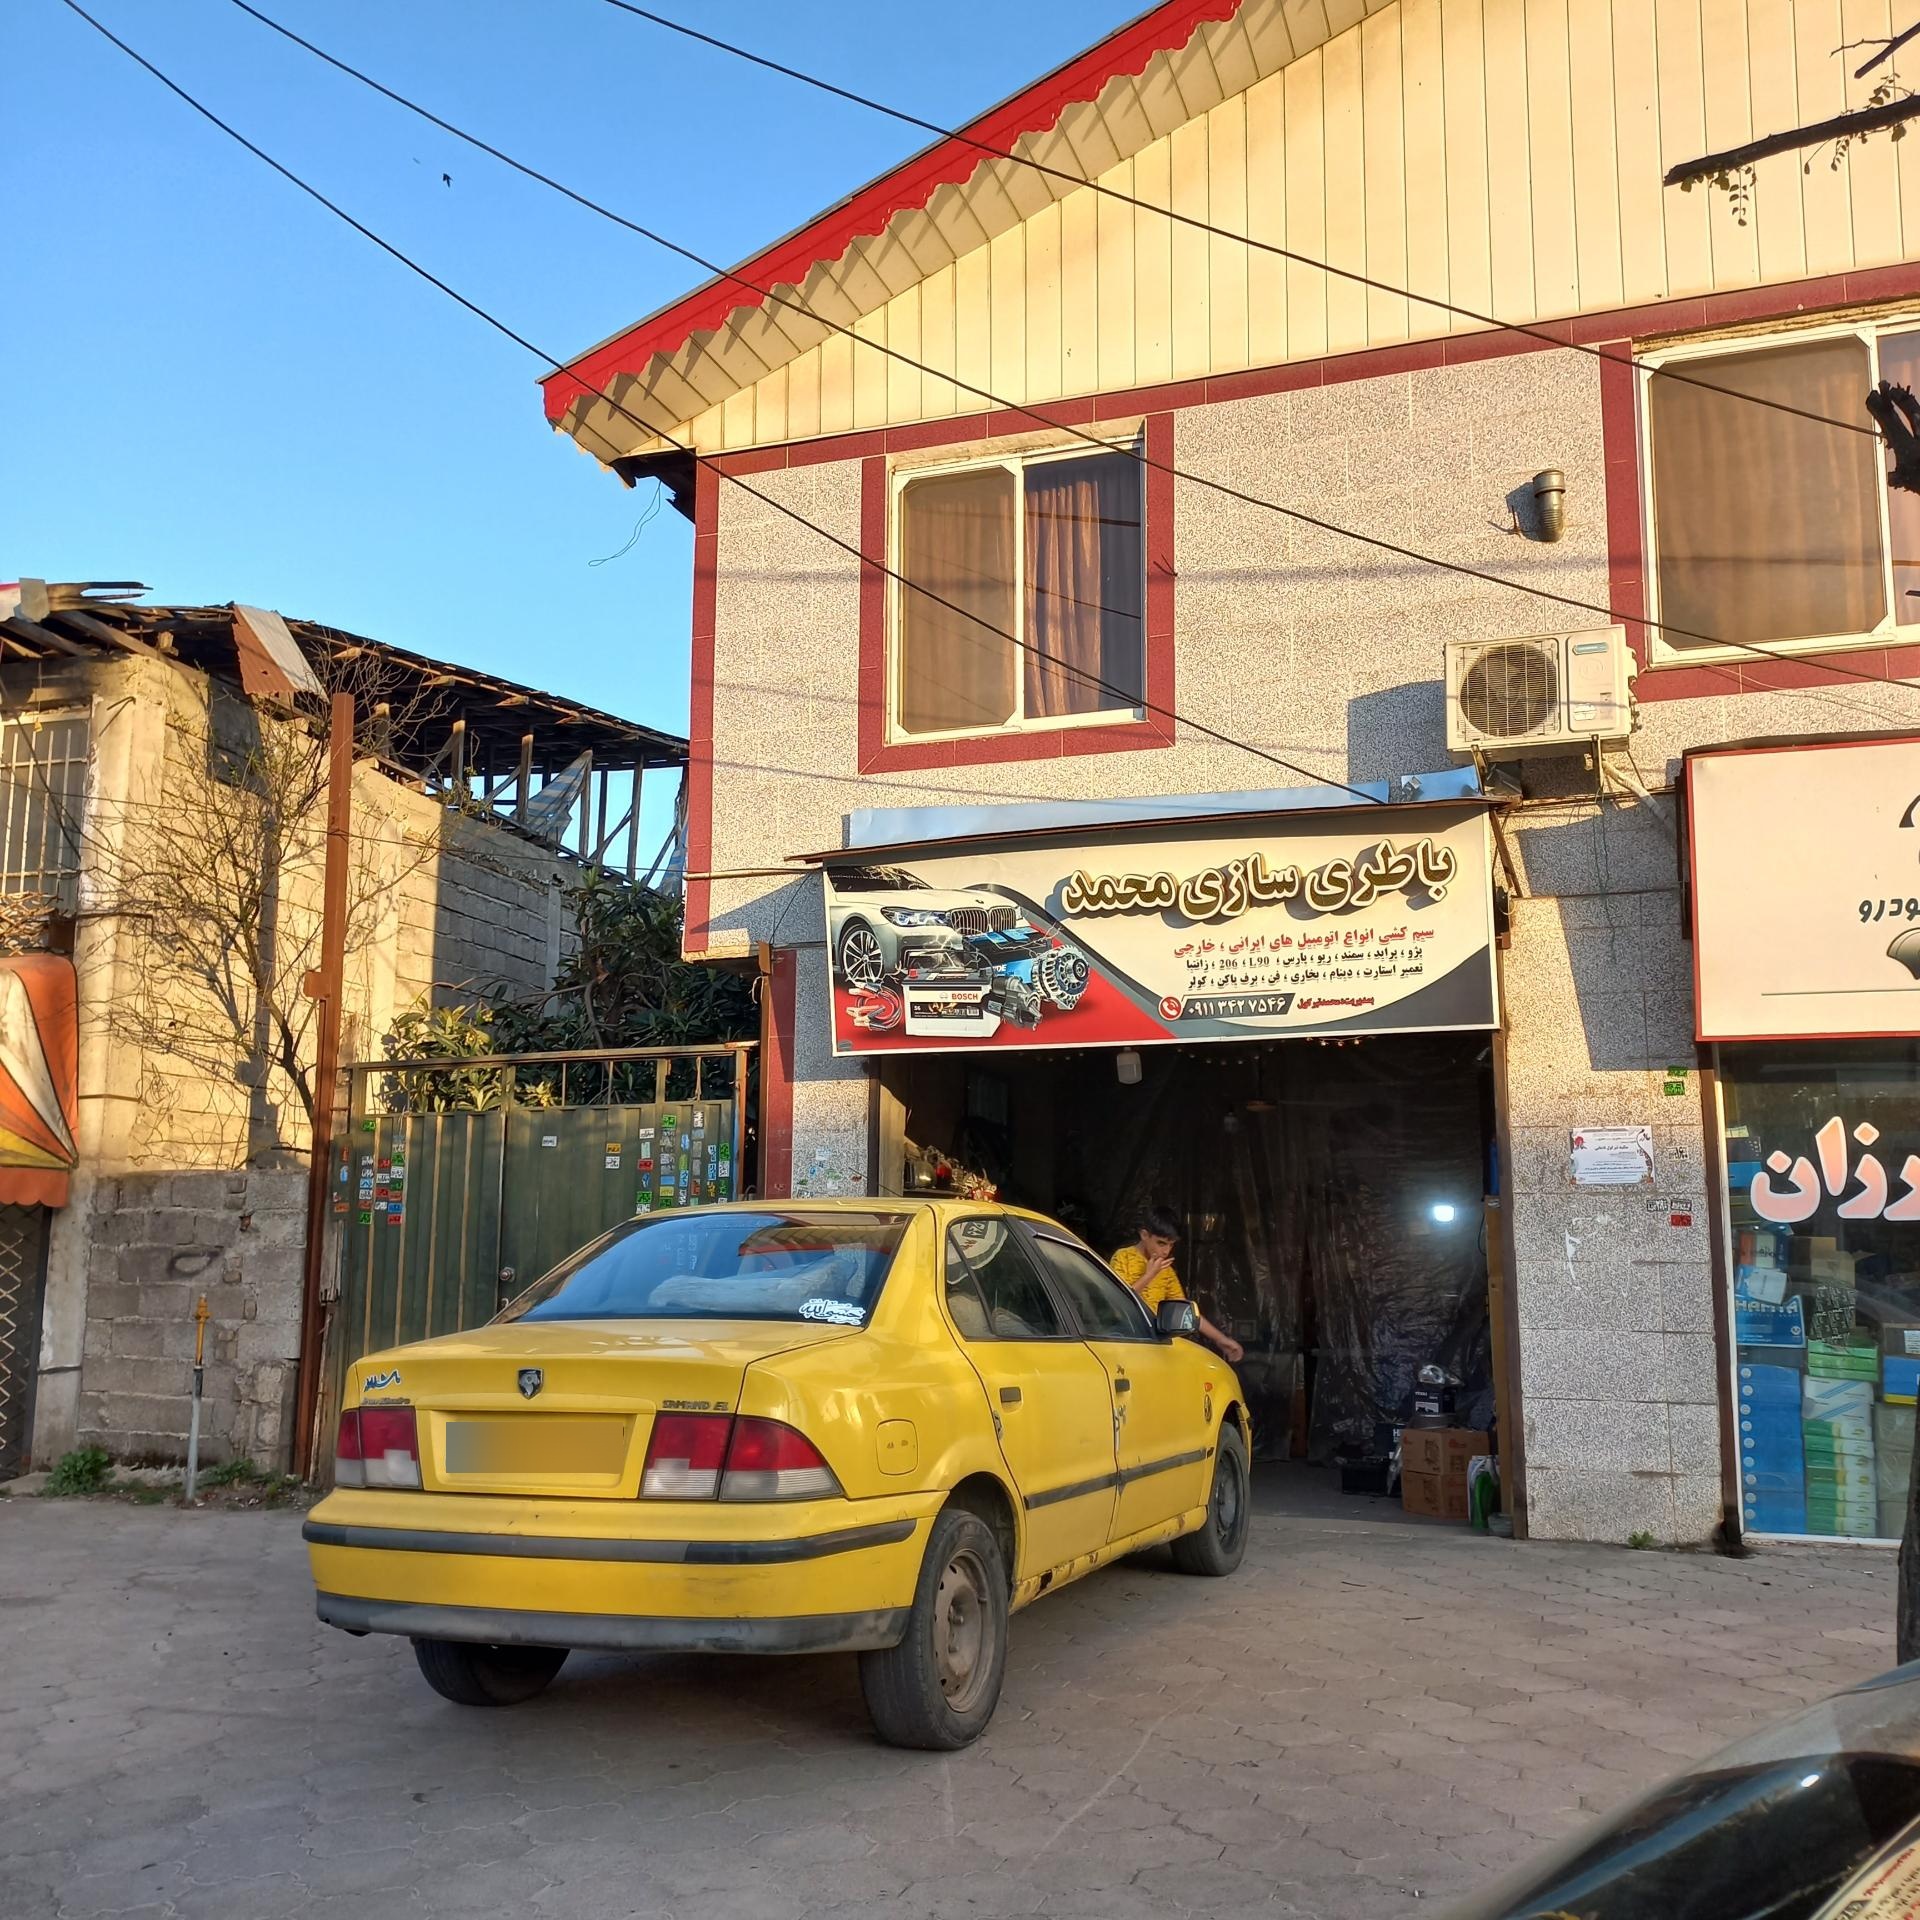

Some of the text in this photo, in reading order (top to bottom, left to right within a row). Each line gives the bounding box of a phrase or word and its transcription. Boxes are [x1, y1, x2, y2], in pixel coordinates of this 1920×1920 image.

[1061, 838, 1457, 920] باطری سازی محمد
[1858, 897, 1920, 923] ودرو
[1269, 934, 1293, 952] های
[1298, 930, 1339, 949] اتومبیل
[1343, 928, 1374, 947] انواع
[1379, 926, 1407, 945] کشی
[1412, 928, 1434, 943] سیم
[1174, 938, 1215, 957] خارجی
[1239, 972, 1258, 986] برف
[1400, 963, 1423, 978] تعمیر
